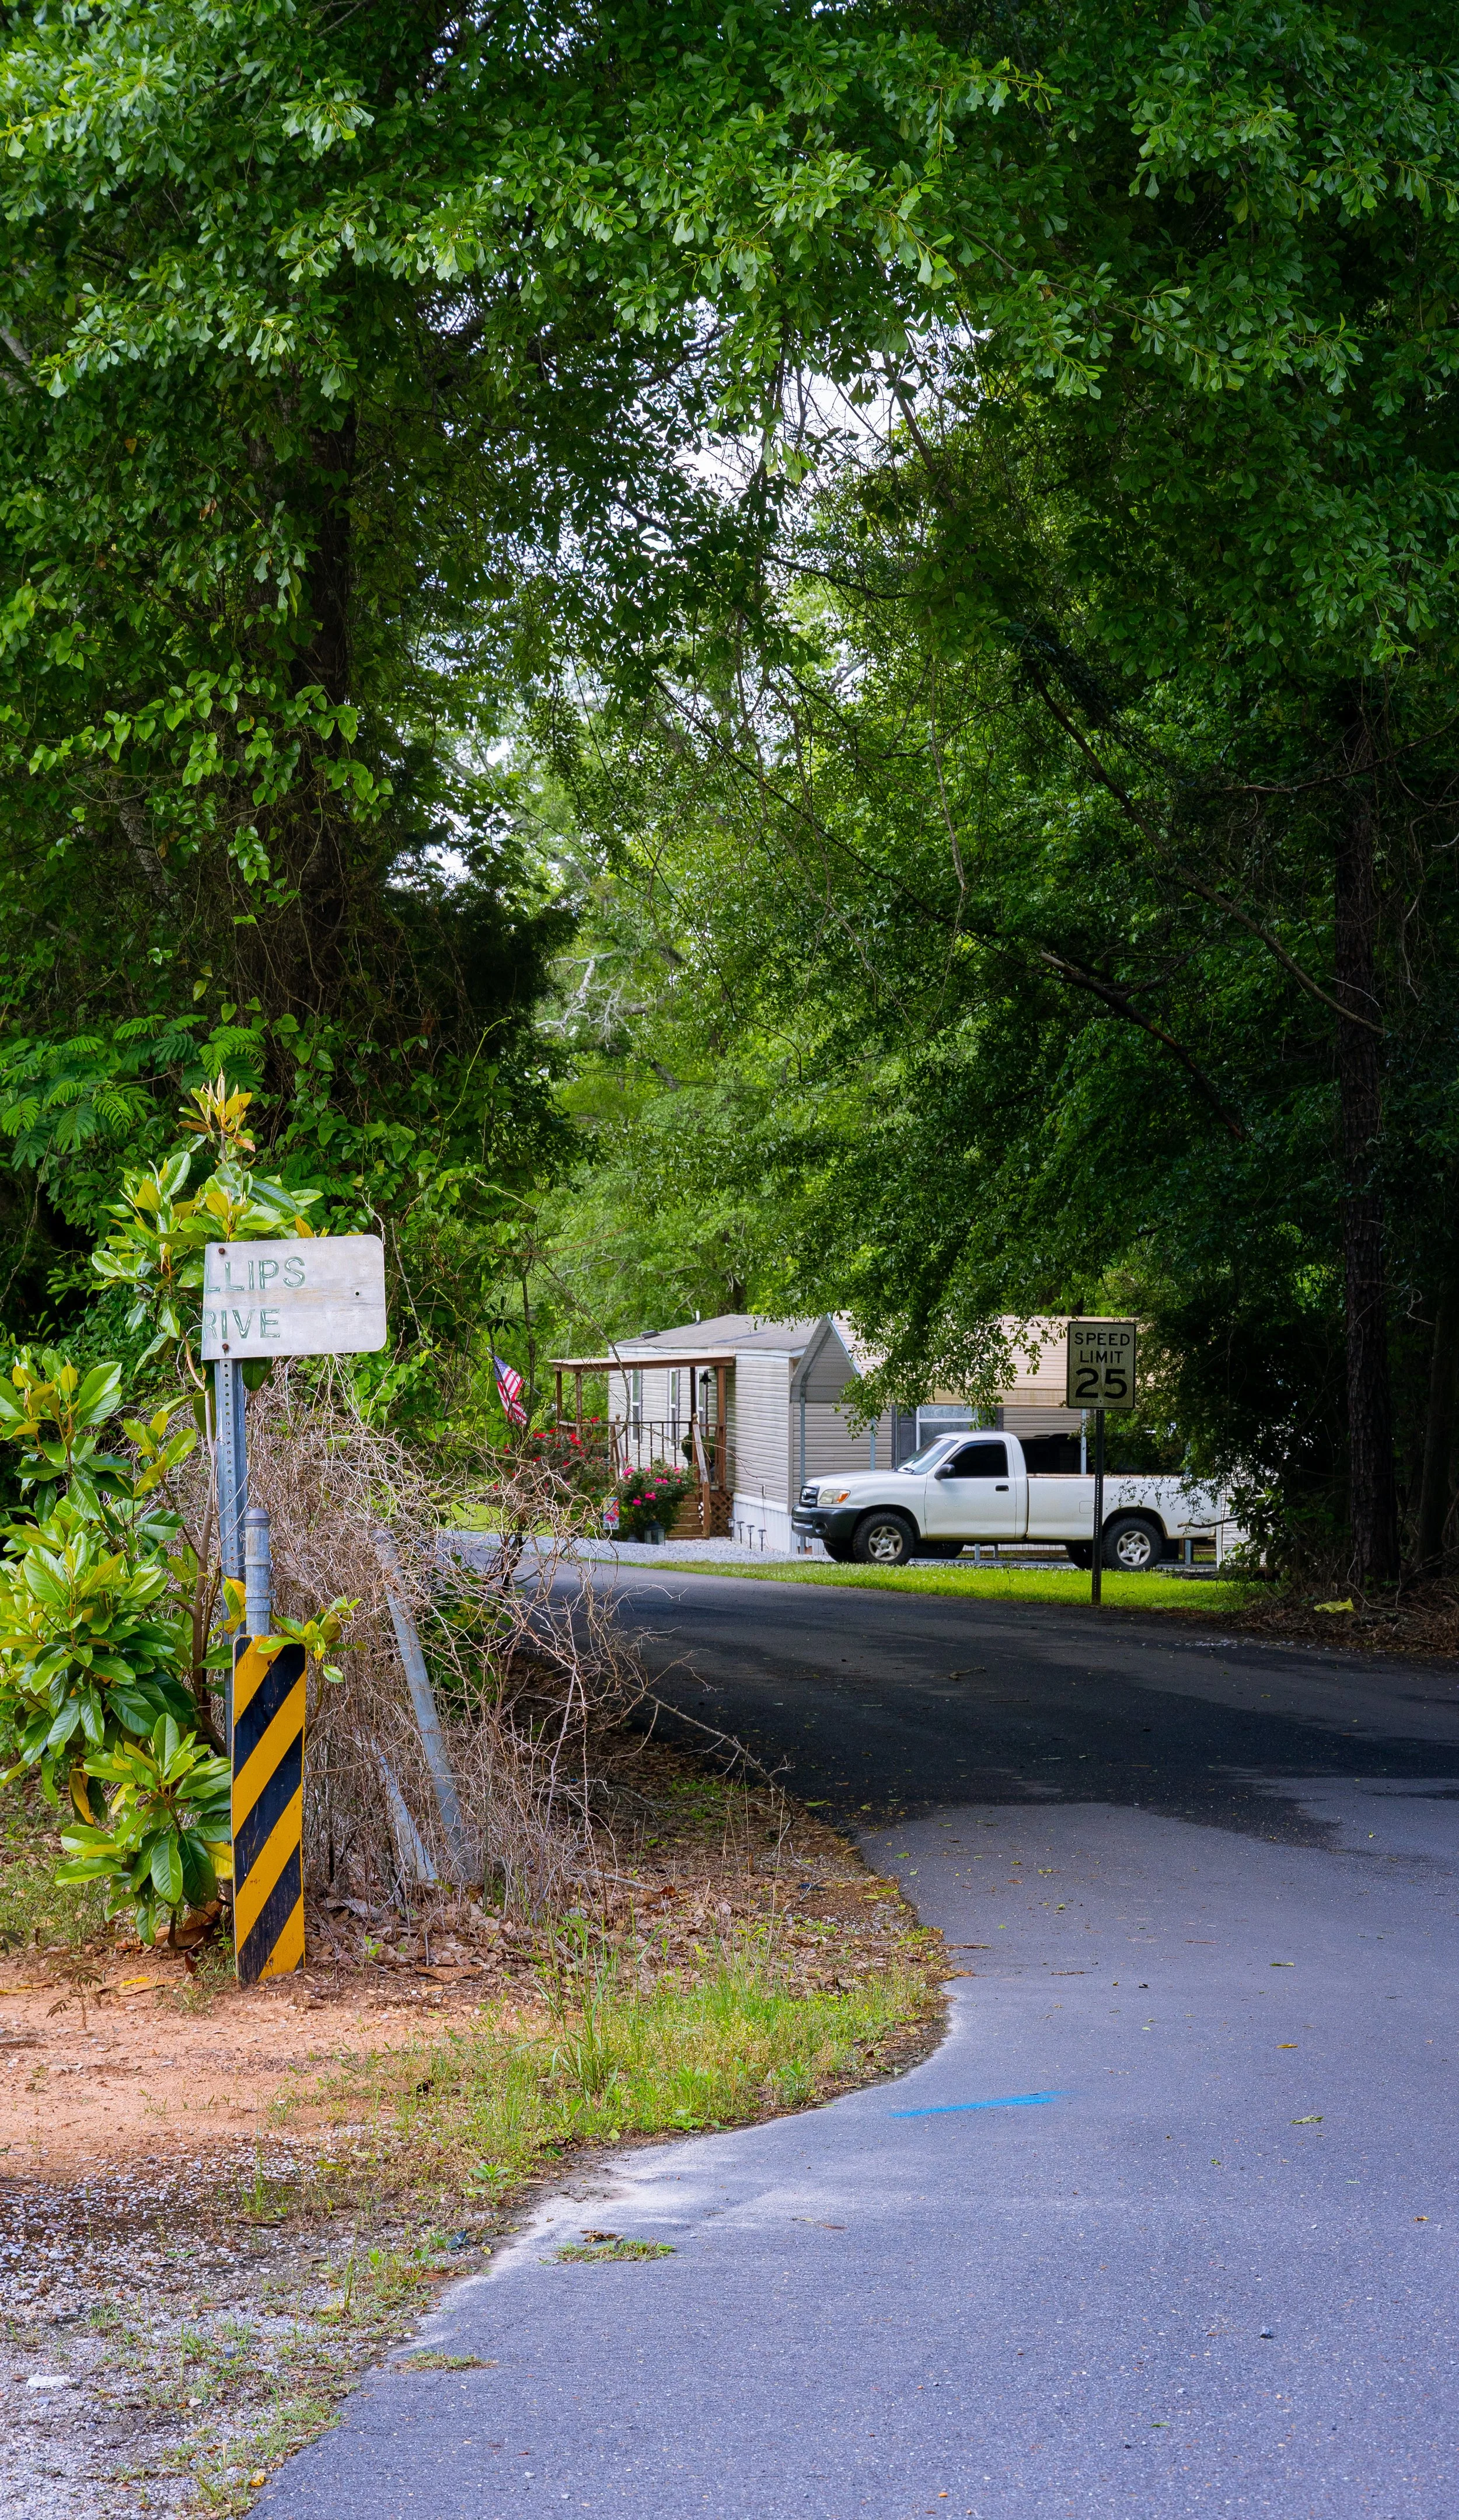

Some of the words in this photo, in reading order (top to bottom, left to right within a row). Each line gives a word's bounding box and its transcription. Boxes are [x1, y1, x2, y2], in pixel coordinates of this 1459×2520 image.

[203, 1308, 281, 1340] RIVE
[1074, 1332, 1130, 1346] SPEED
[1080, 1350, 1123, 1364] LIMIT
[1075, 1367, 1128, 1399] 25
